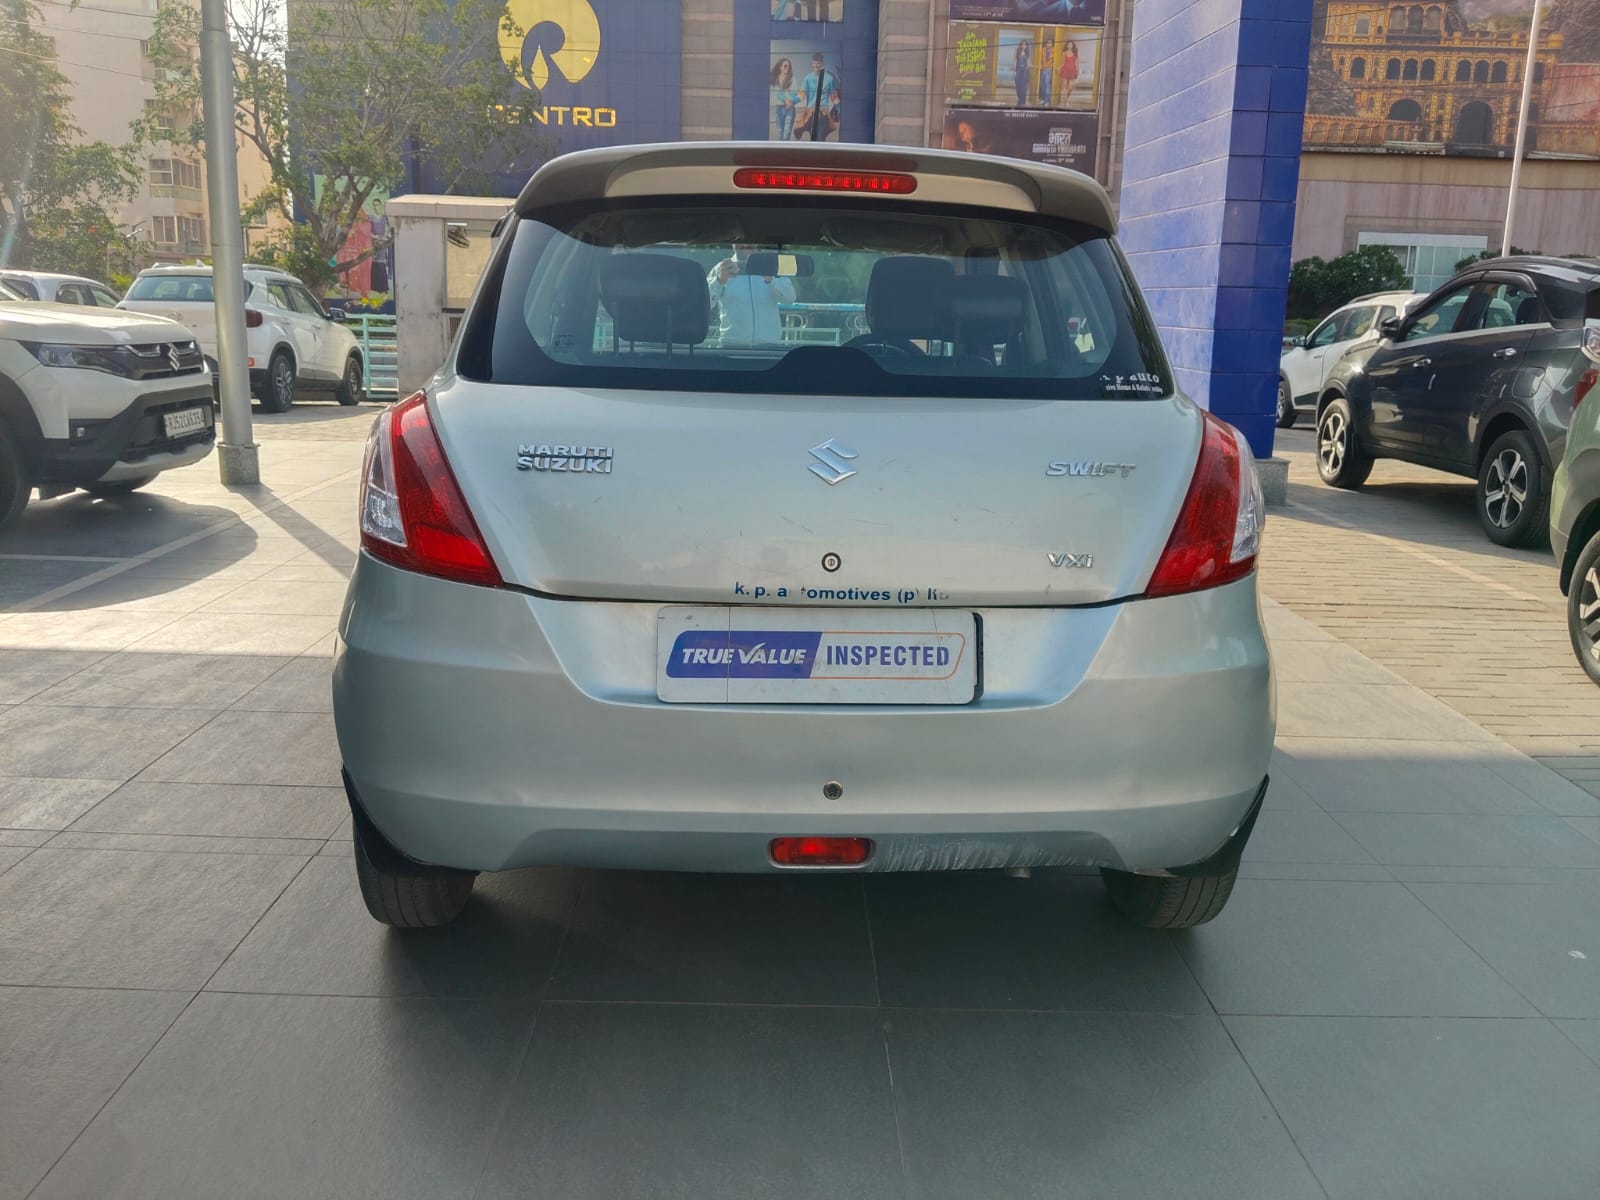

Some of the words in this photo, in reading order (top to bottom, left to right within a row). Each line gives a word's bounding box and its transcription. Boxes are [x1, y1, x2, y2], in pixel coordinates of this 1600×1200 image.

[518, 444, 614, 458] MARUTI
[517, 457, 613, 473] SUZUKI
[1046, 462, 1136, 478] SWIFT
[682, 648, 732, 665] TRUE
[737, 642, 807, 665] VALUE
[826, 645, 950, 666] INSPECTED
